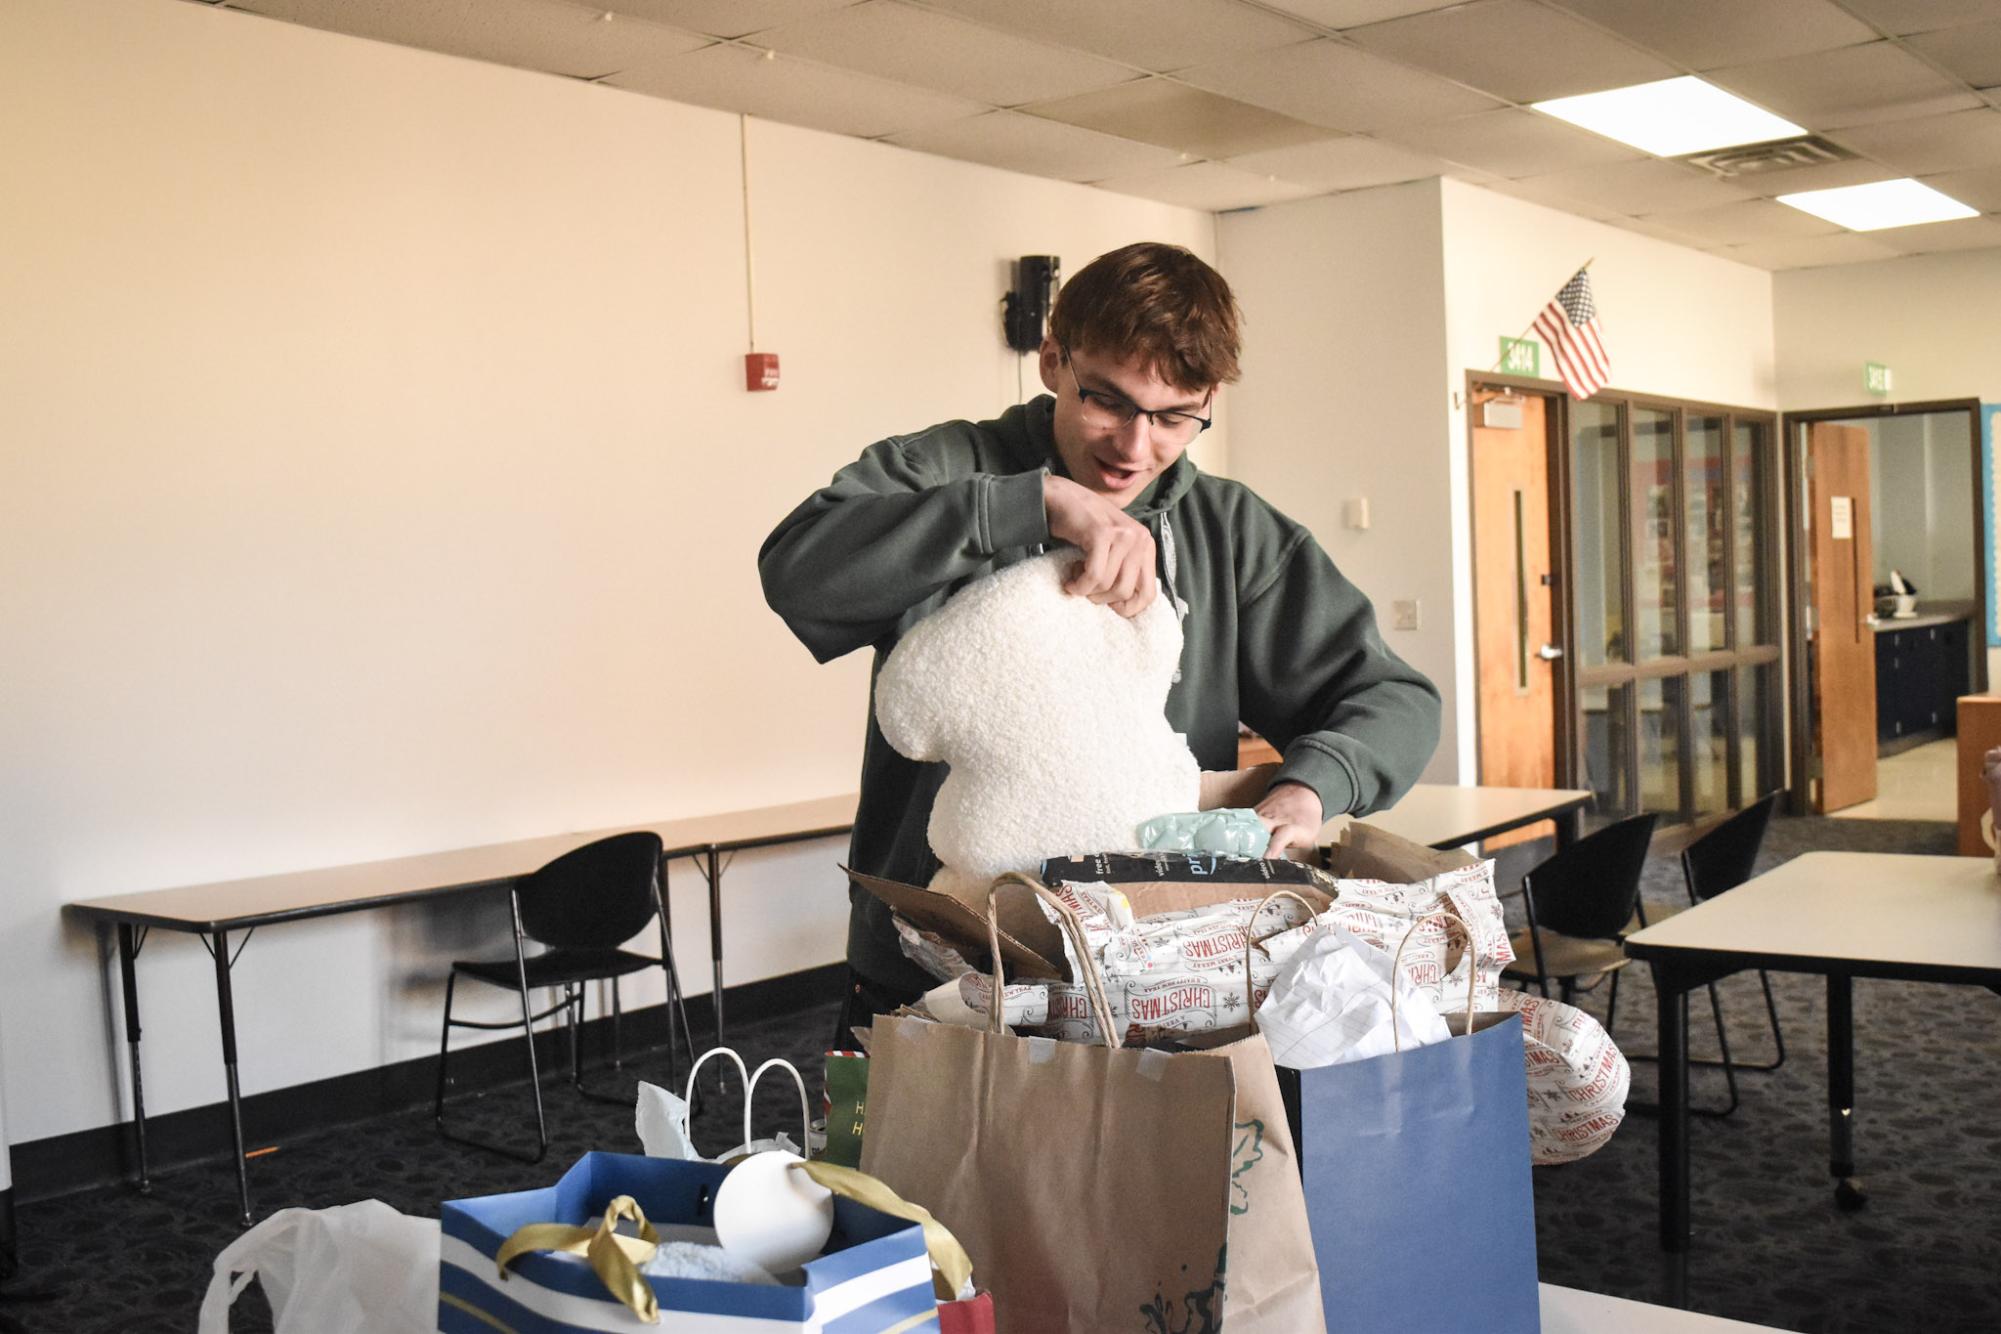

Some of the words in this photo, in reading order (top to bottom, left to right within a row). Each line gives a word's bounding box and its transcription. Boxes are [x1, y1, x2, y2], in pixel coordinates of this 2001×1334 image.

[1185, 854, 1208, 875] pri
[1183, 929, 1247, 958] HRISTMAS
[1131, 987, 1211, 1020] CHRISTMAS
[1568, 1043, 1618, 1101] CHRISTMAS
